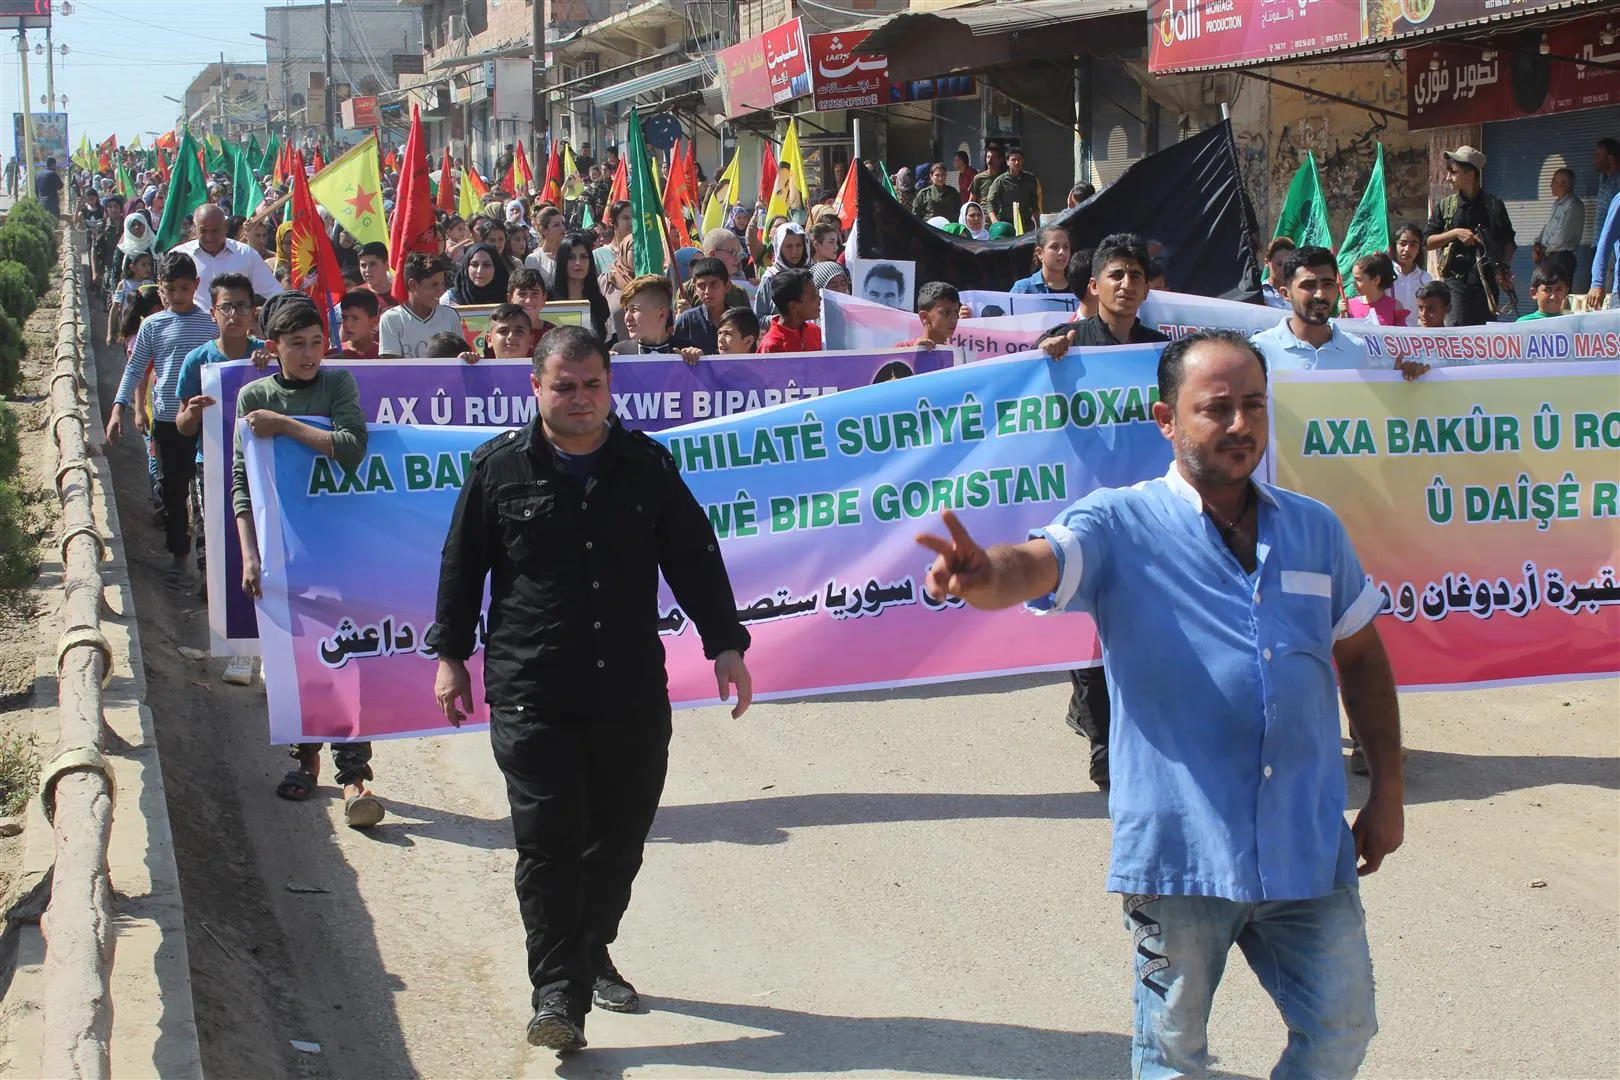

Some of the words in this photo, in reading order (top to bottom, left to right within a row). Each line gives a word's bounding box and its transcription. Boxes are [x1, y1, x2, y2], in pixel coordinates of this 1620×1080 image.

[1206, 0, 1234, 15] MONTAGE
[1206, 14, 1242, 33] PRODUCTION
[1414, 59, 1450, 114] فوري
[1452, 49, 1499, 101] تصوير
[949, 334, 998, 353] rkish
[1383, 335, 1521, 359] SUPPRESSION
[1526, 334, 1569, 358] AND
[1574, 333, 1620, 357] MAS
[375, 397, 420, 425] AX
[430, 387, 452, 425] Û
[465, 387, 539, 425] RÛM
[309, 455, 395, 494] AXA
[668, 411, 827, 473] JHILATÊ
[837, 393, 985, 456] SURÎYÊ
[1303, 419, 1377, 456] AXA
[1387, 405, 1520, 454] BAKÛR
[1534, 404, 1560, 450] Û
[770, 489, 861, 533] BIBE
[872, 463, 1066, 521] GORISTAN
[1427, 477, 1453, 524] Û
[1465, 472, 1580, 530] DAÎŞÊ
[825, 577, 914, 617] سوريا
[1422, 563, 1538, 617] أردوغان
[1546, 568, 1620, 611] قبرة
